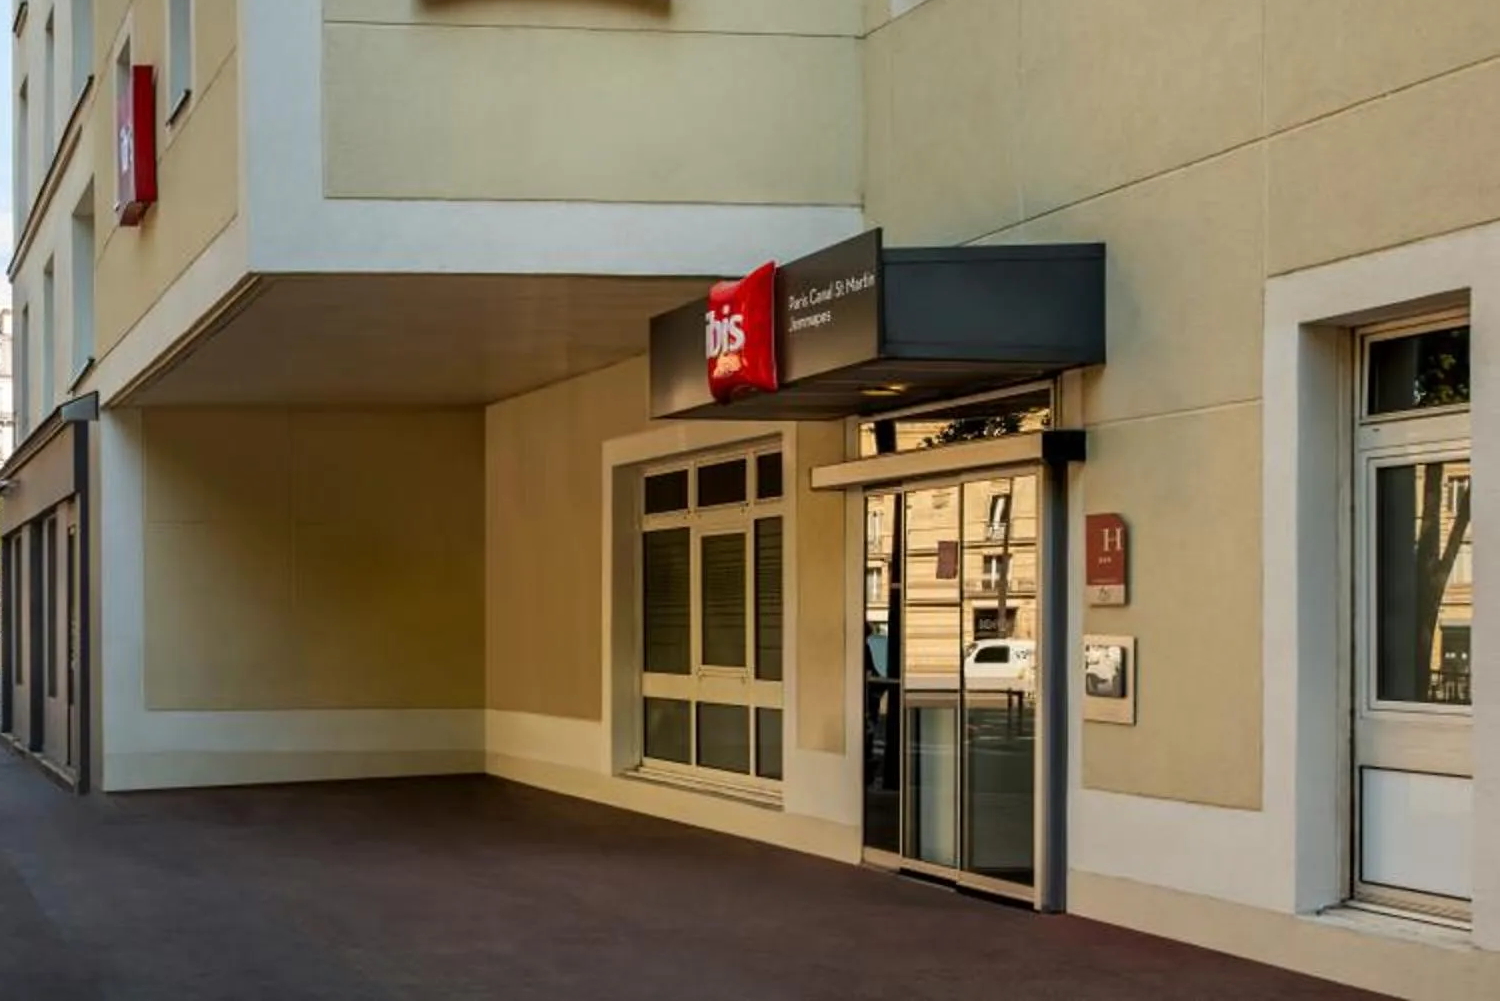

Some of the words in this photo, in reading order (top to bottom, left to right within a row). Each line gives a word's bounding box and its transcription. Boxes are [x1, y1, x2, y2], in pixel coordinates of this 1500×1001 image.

[809, 281, 833, 305] Canal
[845, 271, 876, 294] Martin
[705, 303, 745, 359] bis
[1102, 527, 1123, 552] H
